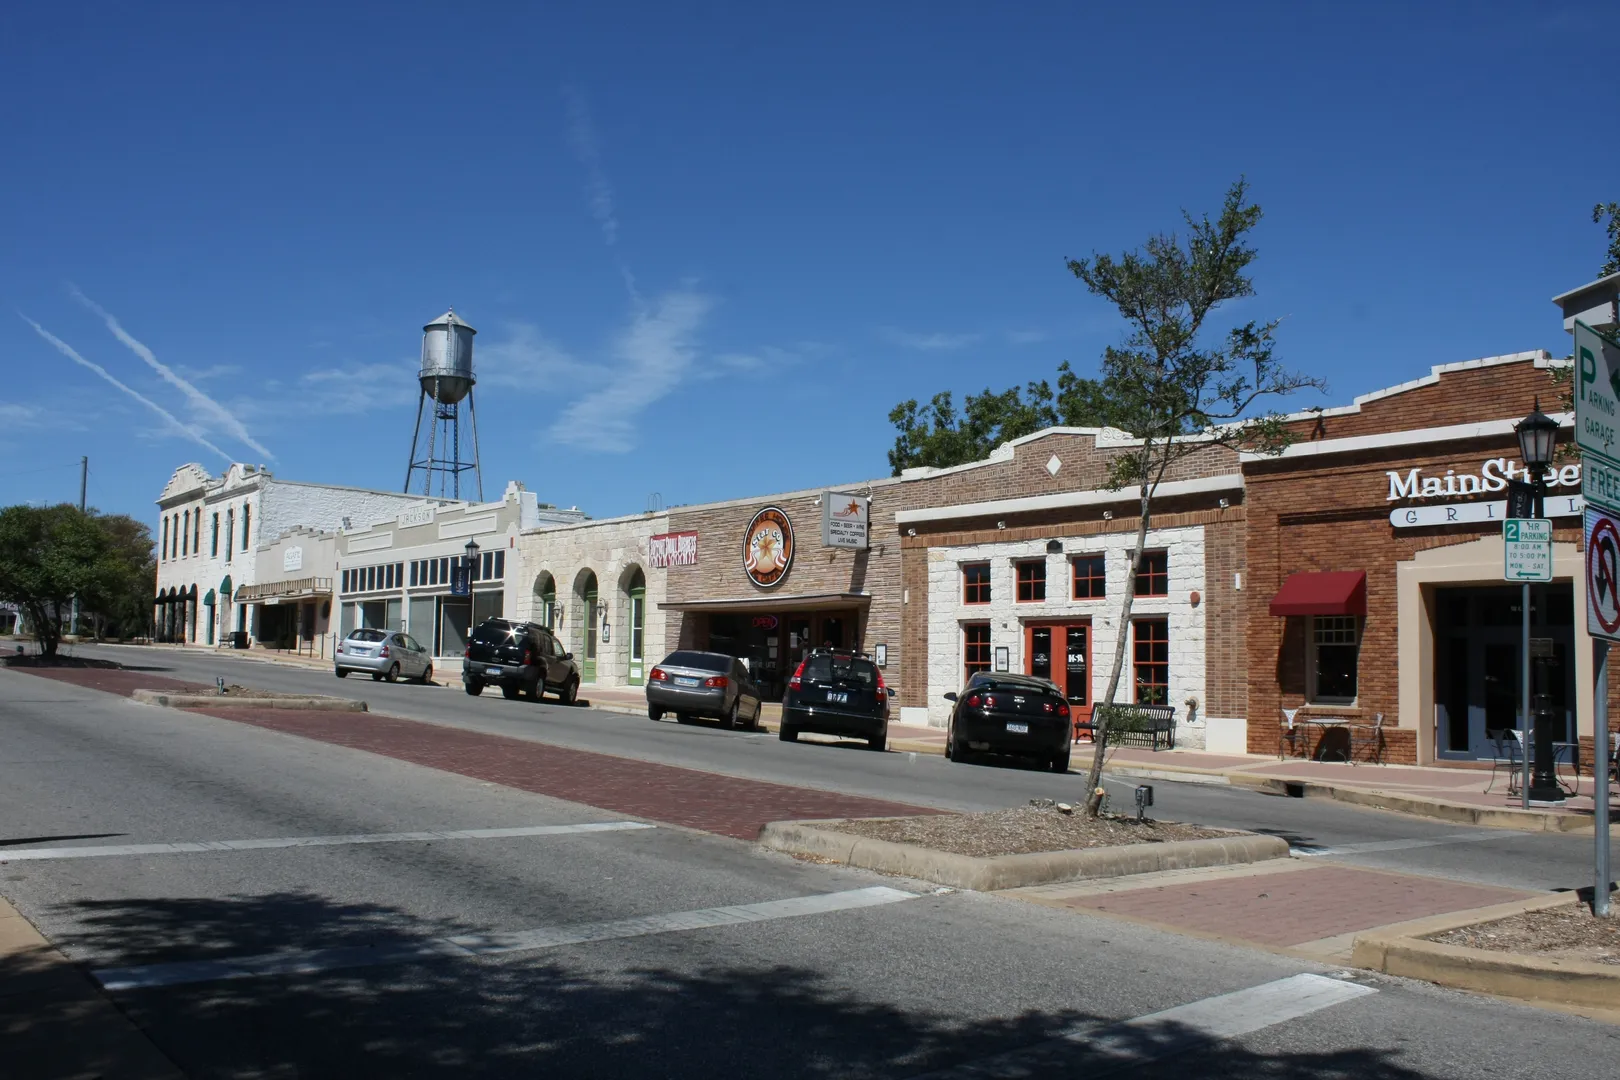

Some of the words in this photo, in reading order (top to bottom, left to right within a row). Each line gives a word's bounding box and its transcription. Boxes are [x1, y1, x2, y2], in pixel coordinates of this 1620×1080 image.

[1580, 345, 1616, 417] PARKING
[1585, 416, 1615, 445] GARAGE
[1386, 458, 1581, 502] MainStree
[1590, 466, 1620, 502] FREE
[401, 510, 432, 525] JACKSON
[1405, 497, 1580, 524] GRIL
[1506, 523, 1517, 539] 2
[1528, 523, 1540, 531] HR
[1520, 532, 1548, 540] PARKING
[752, 615, 774, 628] OPEN
